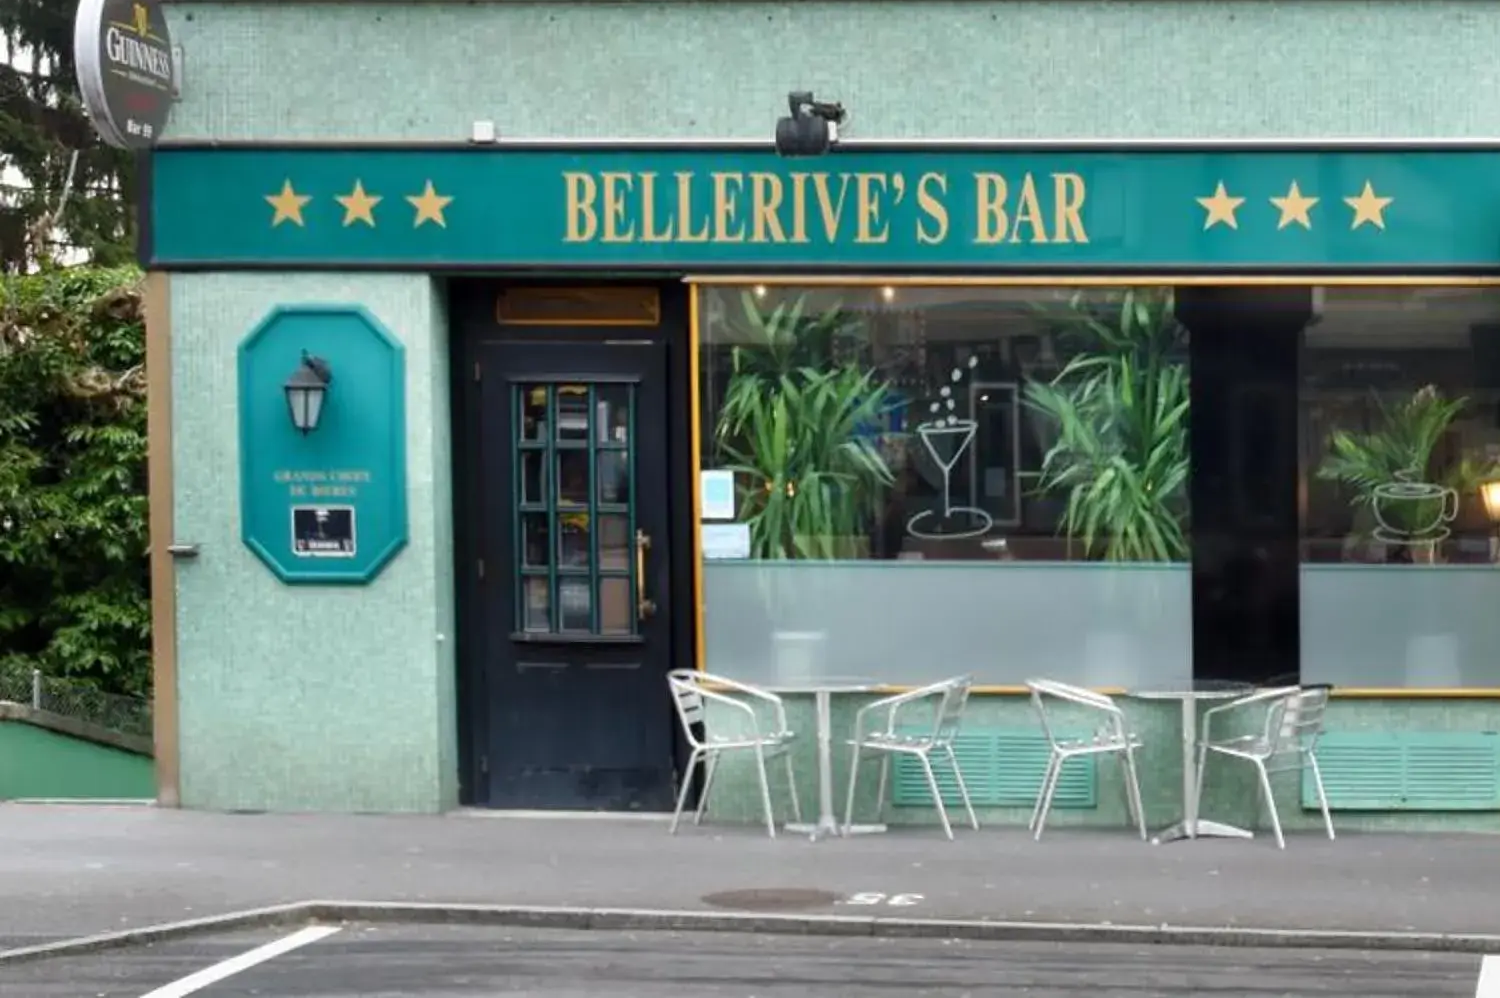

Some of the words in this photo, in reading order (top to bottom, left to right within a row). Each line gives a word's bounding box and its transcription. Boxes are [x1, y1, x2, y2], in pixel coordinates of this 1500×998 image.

[106, 27, 171, 81] GUINNESS
[562, 170, 950, 244] BELLERIVE'S
[973, 171, 1090, 244] BAR
